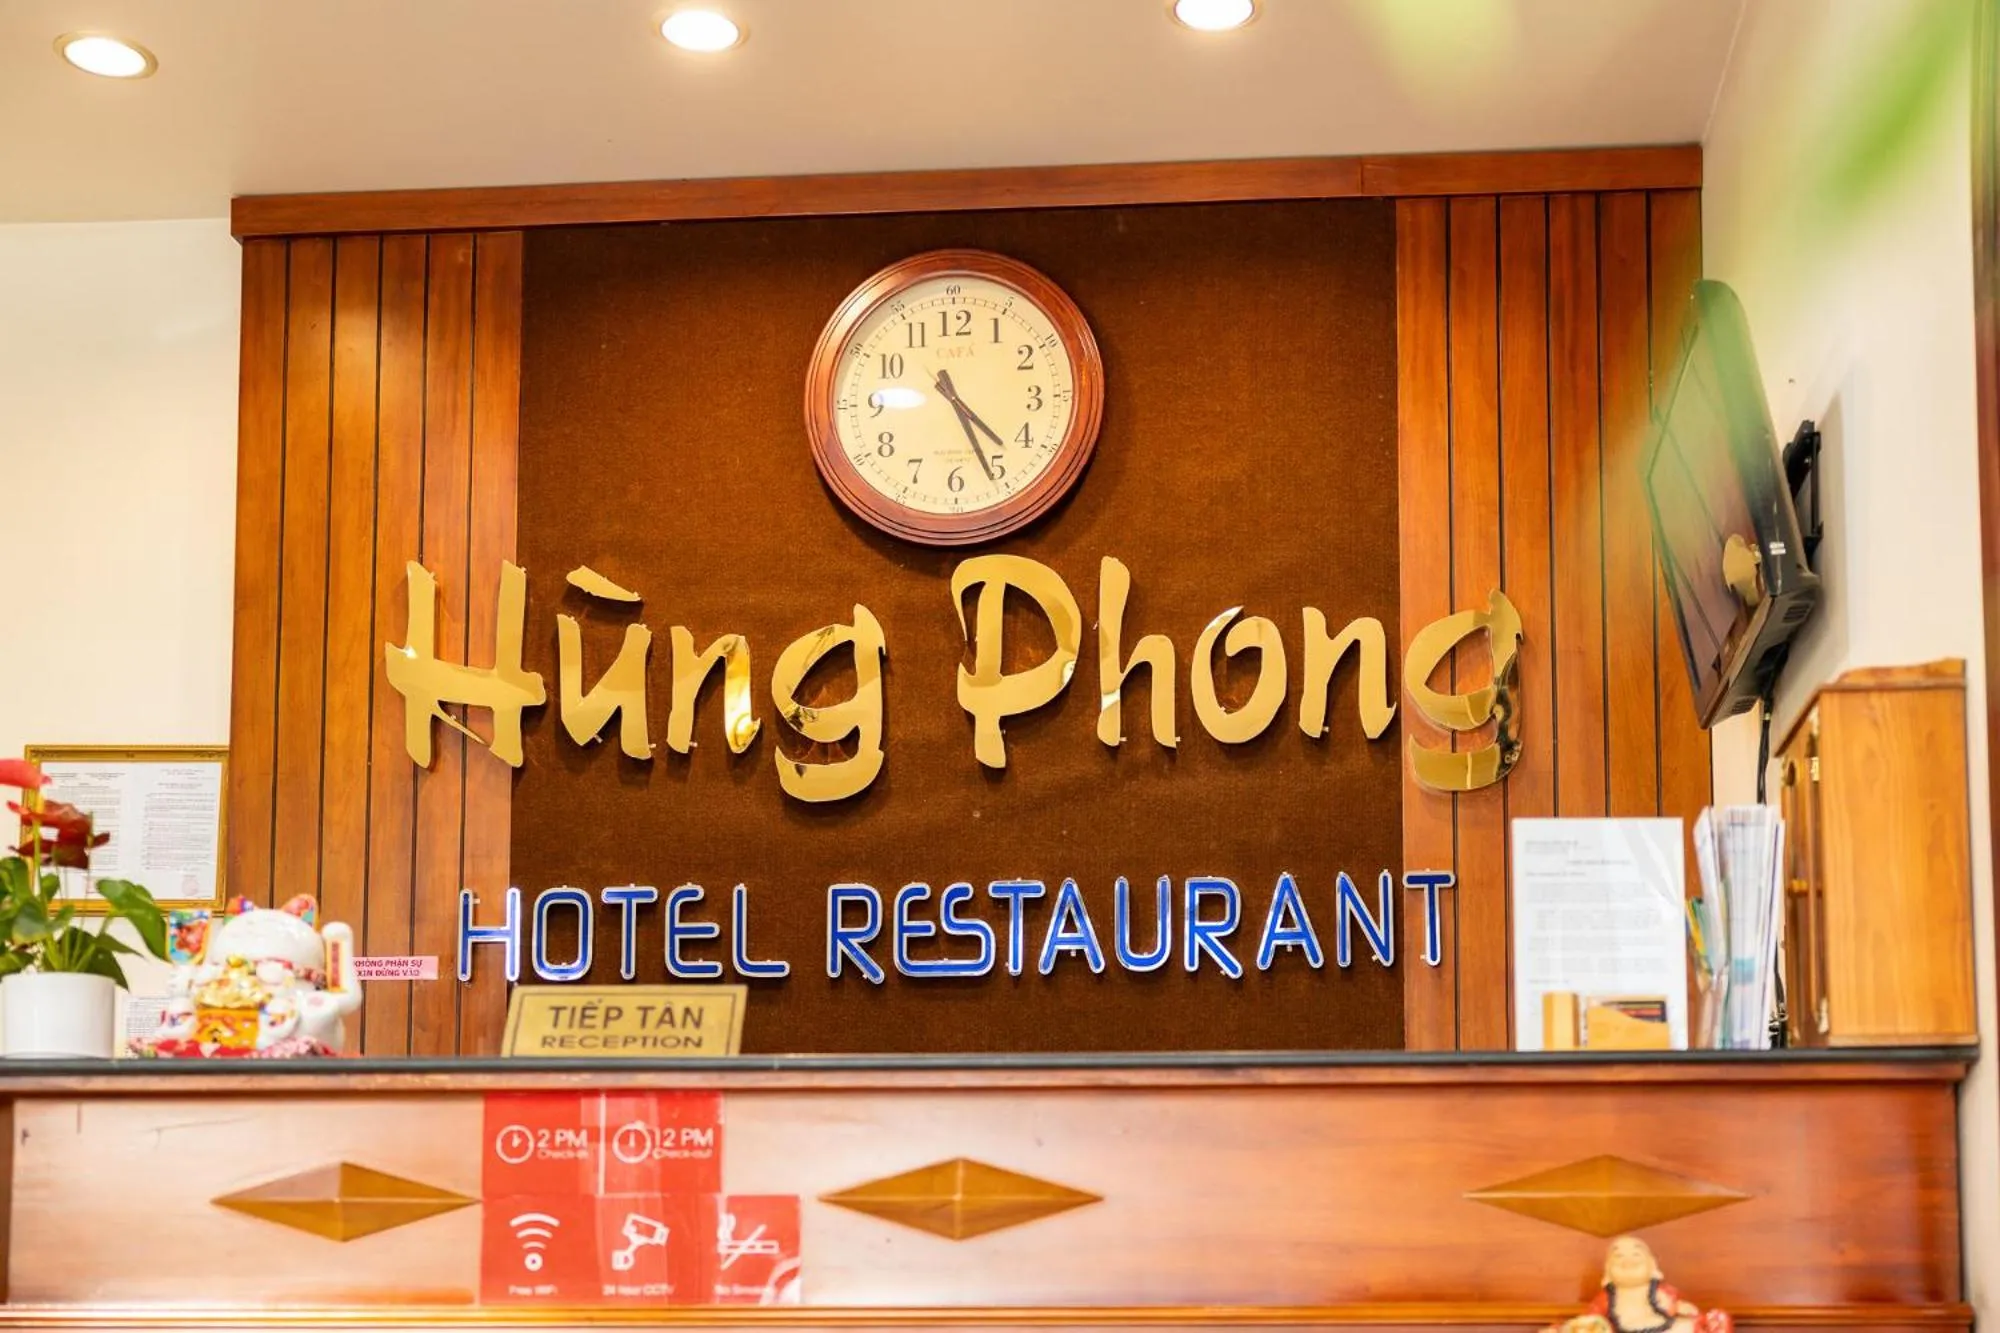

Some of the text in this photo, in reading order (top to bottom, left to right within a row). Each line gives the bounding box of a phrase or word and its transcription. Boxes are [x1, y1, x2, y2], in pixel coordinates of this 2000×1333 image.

[946, 285, 961, 295] 60
[906, 322, 927, 348] 11
[938, 310, 972, 336] 12
[989, 317, 1003, 343] 1
[880, 353, 904, 379] 10
[1017, 344, 1034, 371] 2
[868, 391, 884, 418] 9
[1026, 385, 1043, 412] 3
[877, 431, 895, 458] 8
[1014, 422, 1034, 449] 4
[907, 457, 923, 484] 7
[947, 466, 964, 492] 6
[991, 455, 1006, 481] 5
[385, 554, 1523, 802] Hùng Phong
[457, 884, 790, 982] HOTEL
[826, 871, 1456, 984] RESTAURANT
[549, 998, 704, 1030] TIẾP TÂN
[541, 1035, 703, 1049] RECEPTION
[537, 1129, 588, 1148] 2 PM
[652, 1127, 713, 1148] 12 PM
